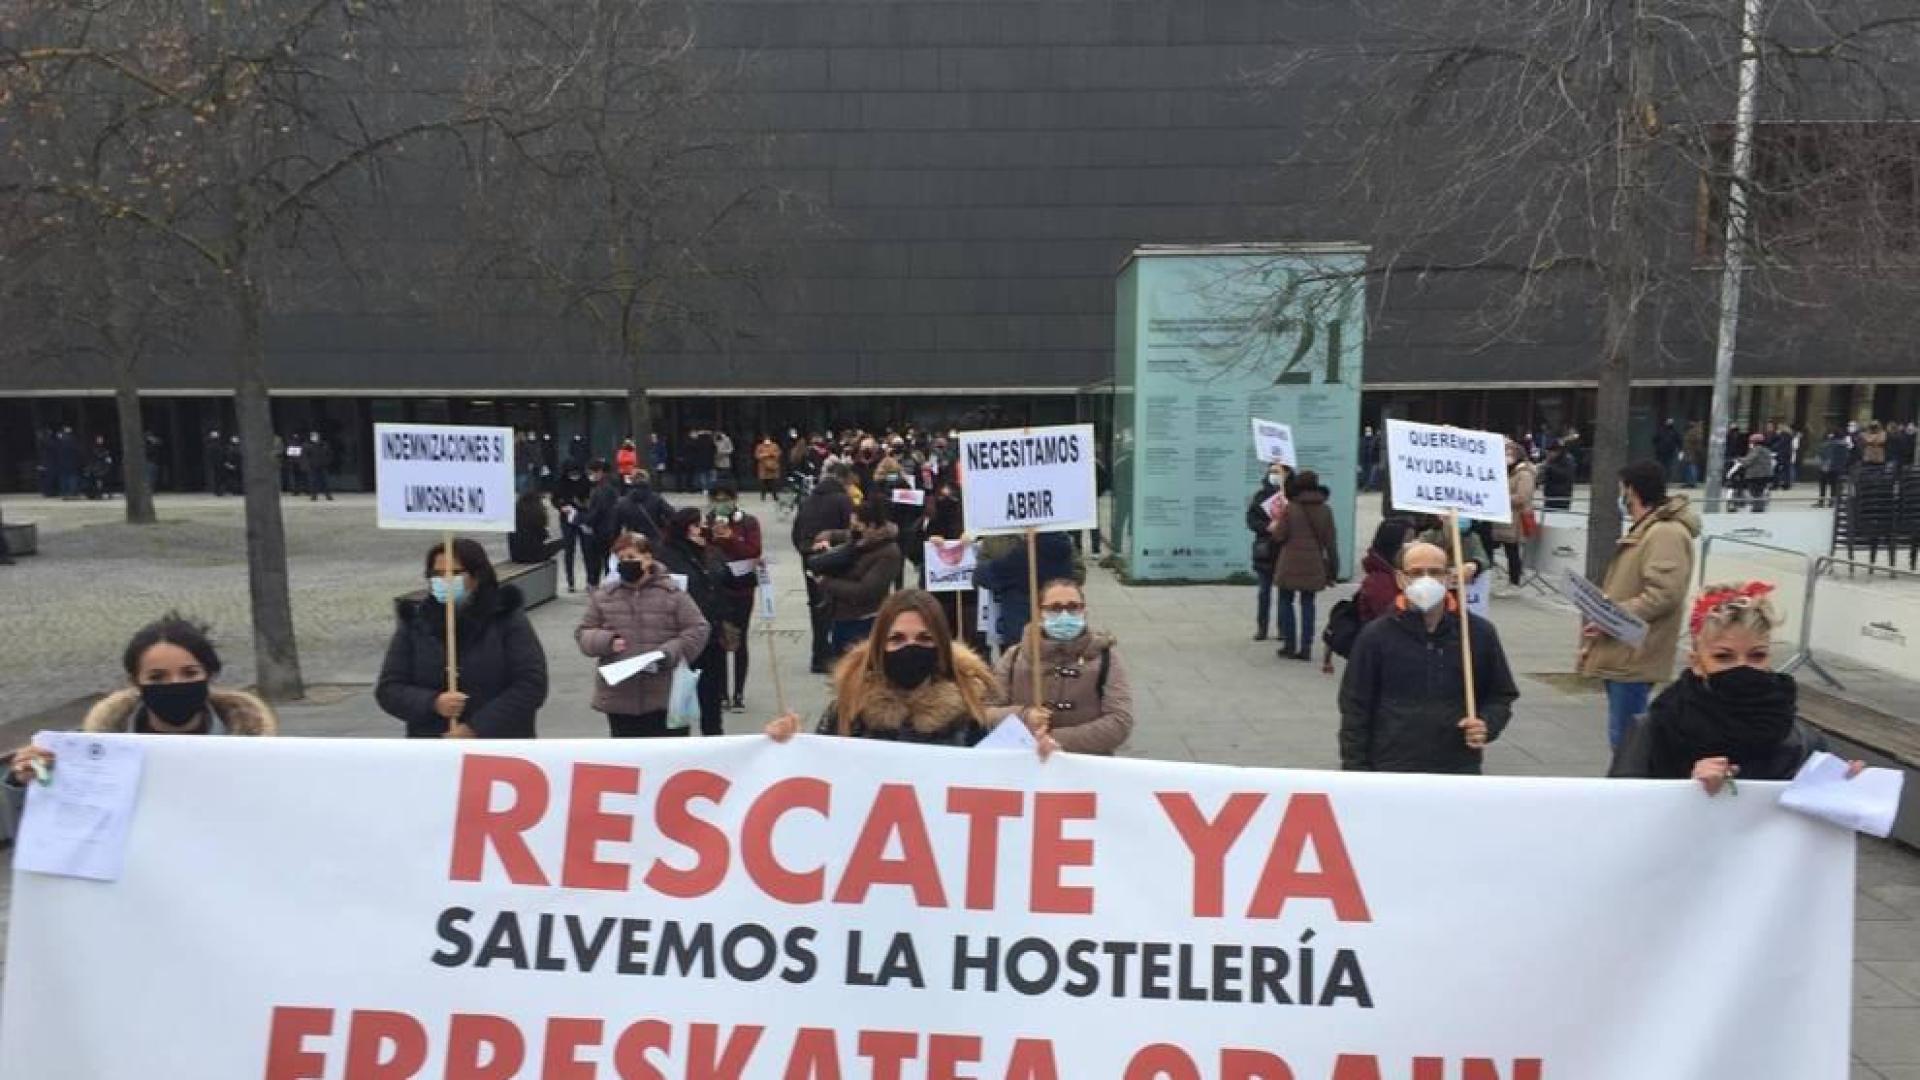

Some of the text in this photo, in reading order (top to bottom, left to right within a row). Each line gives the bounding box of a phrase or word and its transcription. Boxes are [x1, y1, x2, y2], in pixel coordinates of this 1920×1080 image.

[382, 432, 489, 462] INDEMNIZACIONES
[967, 434, 1079, 471] NECESITAMOS
[1409, 430, 1487, 454] QUEREMOS
[1398, 454, 1463, 476] "AYUDAS
[1478, 466, 1496, 482] LA
[404, 485, 485, 513] LIMOSNAS NO
[1006, 489, 1055, 520] ABRIR
[449, 754, 1370, 921] RESCATE YA
[431, 906, 1375, 1009] SALVEMOS LA HOSTELERÍA
